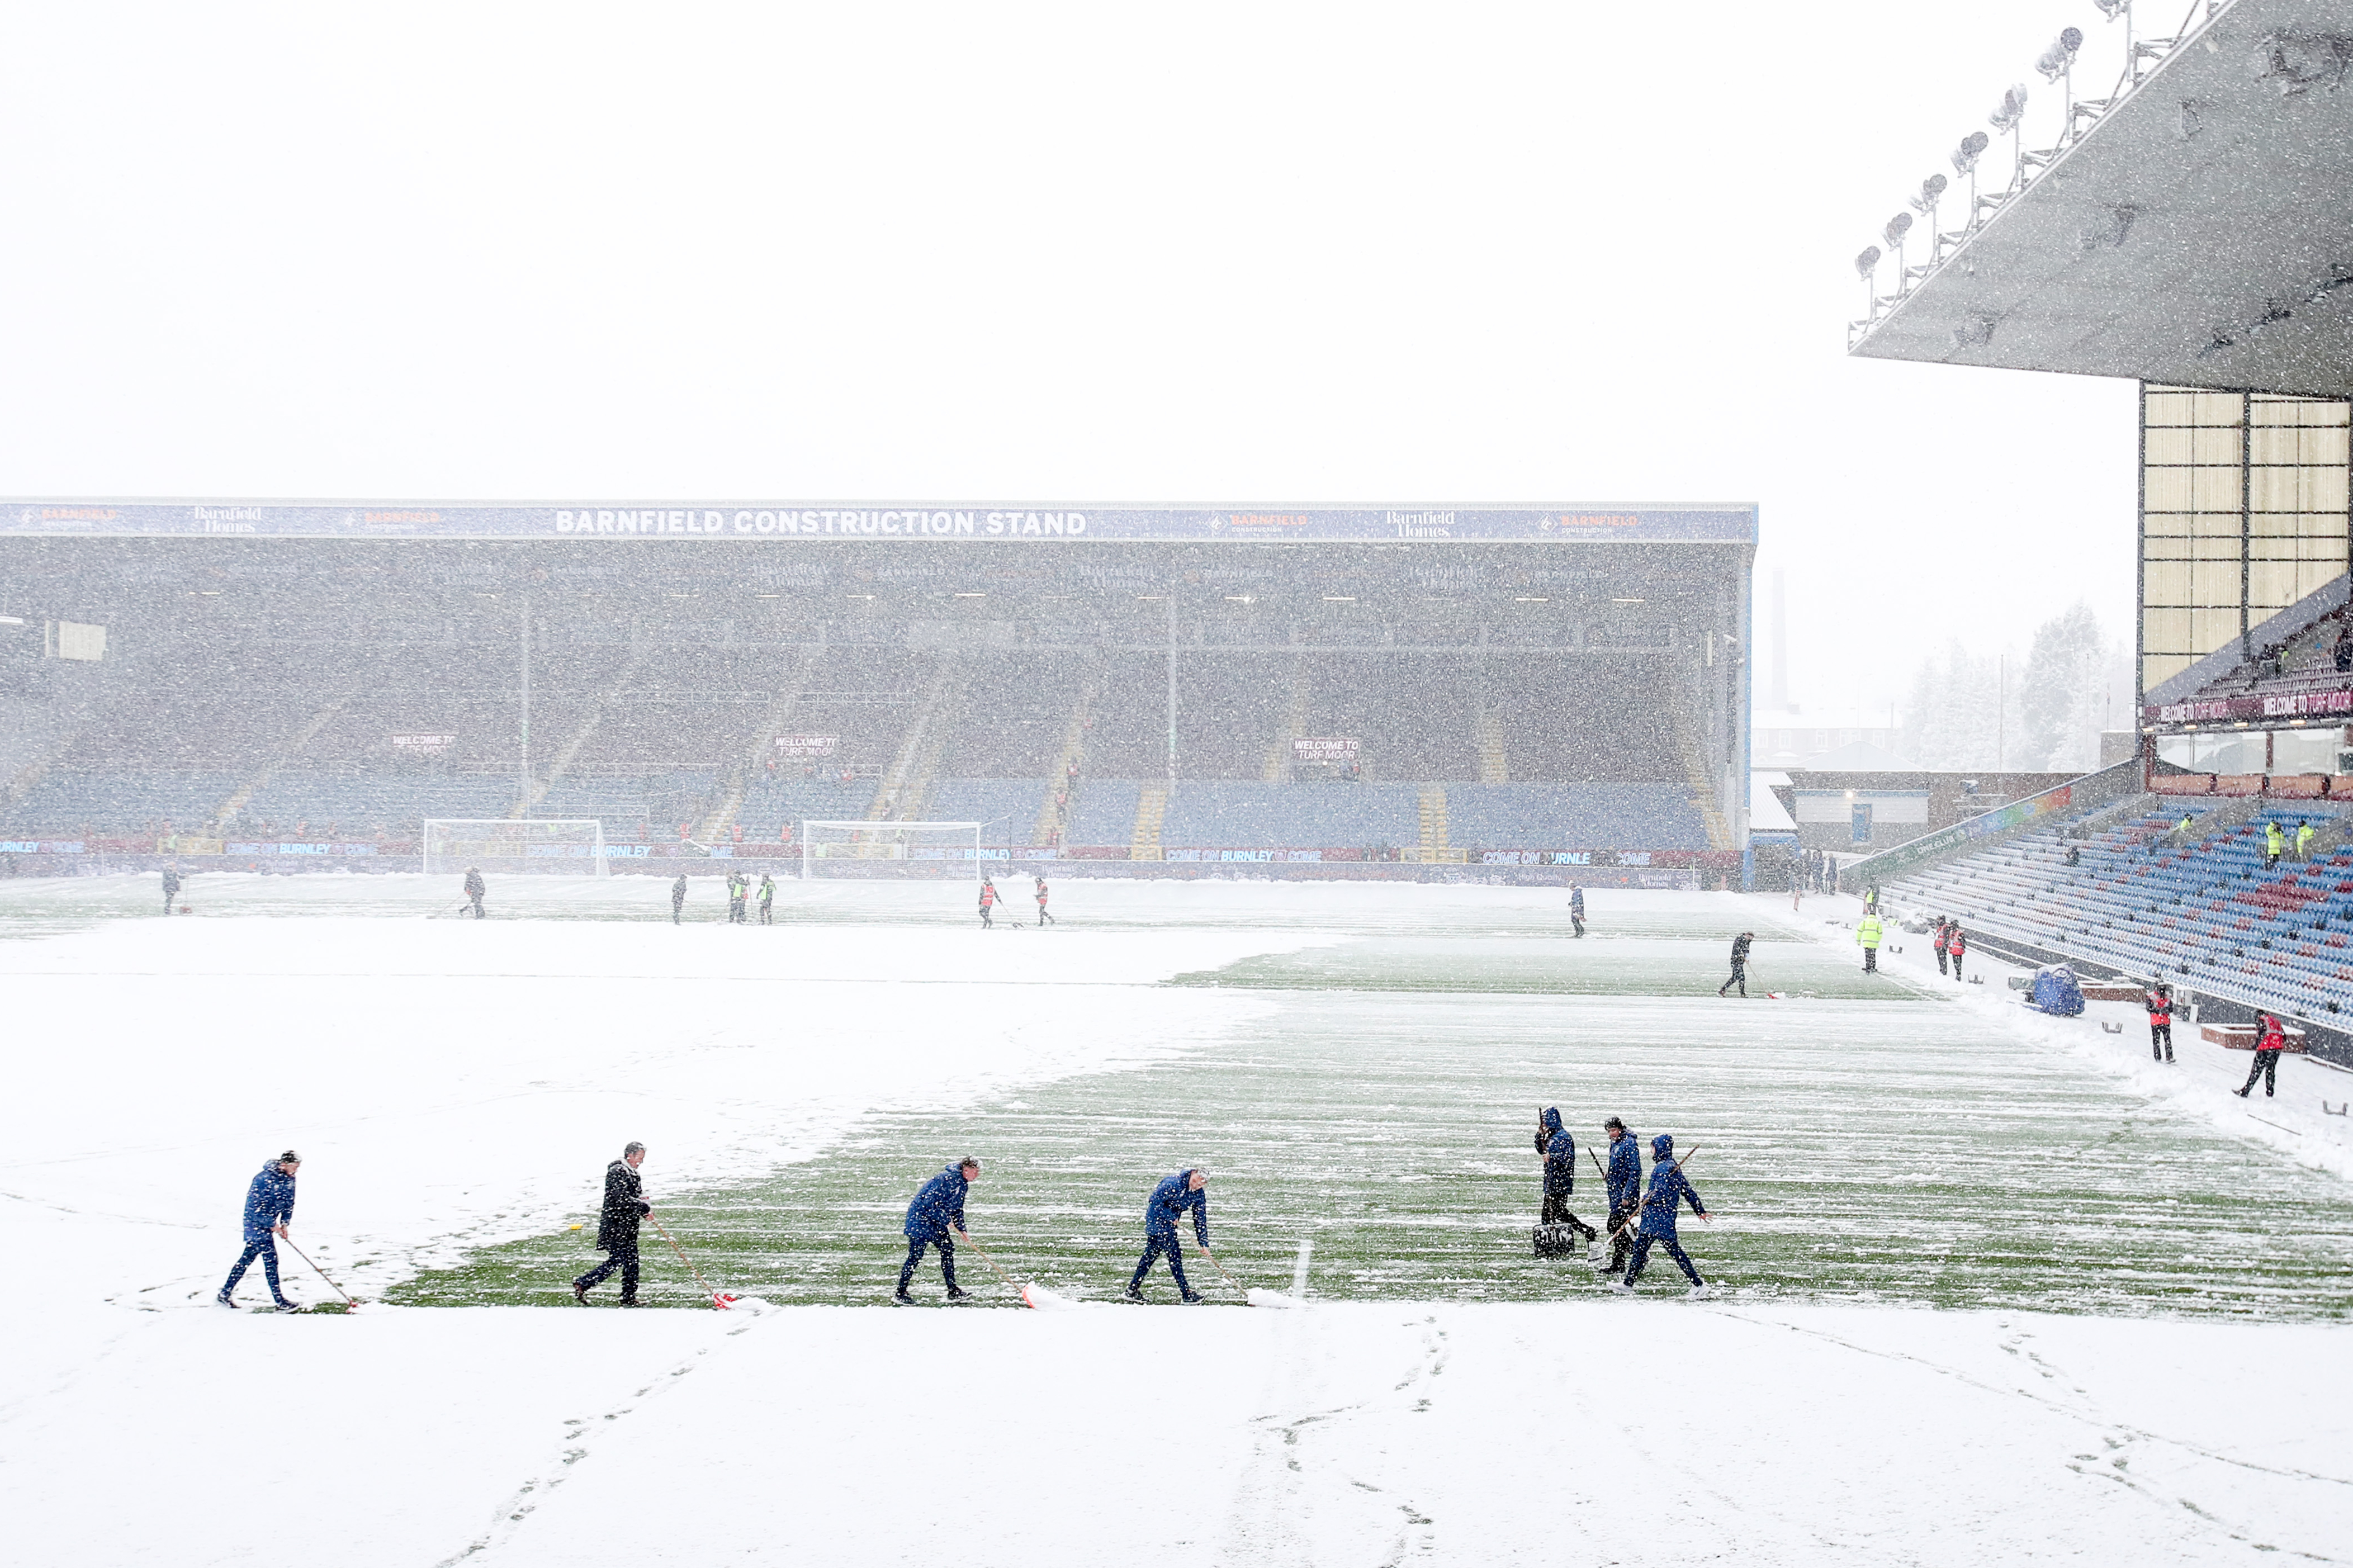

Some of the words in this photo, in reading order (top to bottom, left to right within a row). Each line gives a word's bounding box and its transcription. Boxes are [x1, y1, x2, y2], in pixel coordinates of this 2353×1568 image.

[194, 506, 262, 520] Barnfield
[1386, 511, 1455, 524] Barnfield
[556, 510, 724, 532] BARNFIELD
[733, 510, 975, 533] CONSTRUCTION
[986, 512, 1086, 534] STAND
[1231, 515, 1308, 525] BARNFIELD
[1561, 515, 1638, 526] BARNFIELD
[205, 520, 256, 533] Homes
[1398, 524, 1451, 537] Homes
[2264, 695, 2297, 716] WELCOME
[2298, 694, 2308, 714] TO
[2161, 705, 2186, 722] WELCOME
[2186, 704, 2194, 721] TO
[392, 736, 442, 745] WELCOME
[776, 737, 825, 747] WELCOME
[1295, 741, 1343, 750] WELCOME
[1346, 741, 1358, 750] TO
[1299, 750, 1324, 759] TURF
[280, 843, 332, 854] BURNLEY
[964, 849, 1011, 860] BURNLEY
[1025, 849, 1057, 860] COME
[1166, 850, 1200, 861] COME
[1202, 851, 1220, 861] ON
[1221, 850, 1273, 862] BURNLEY
[1287, 850, 1322, 862] COME
[1483, 852, 1519, 864] COME
[1521, 852, 1540, 864] ON
[1551, 852, 1590, 865] URNLE
